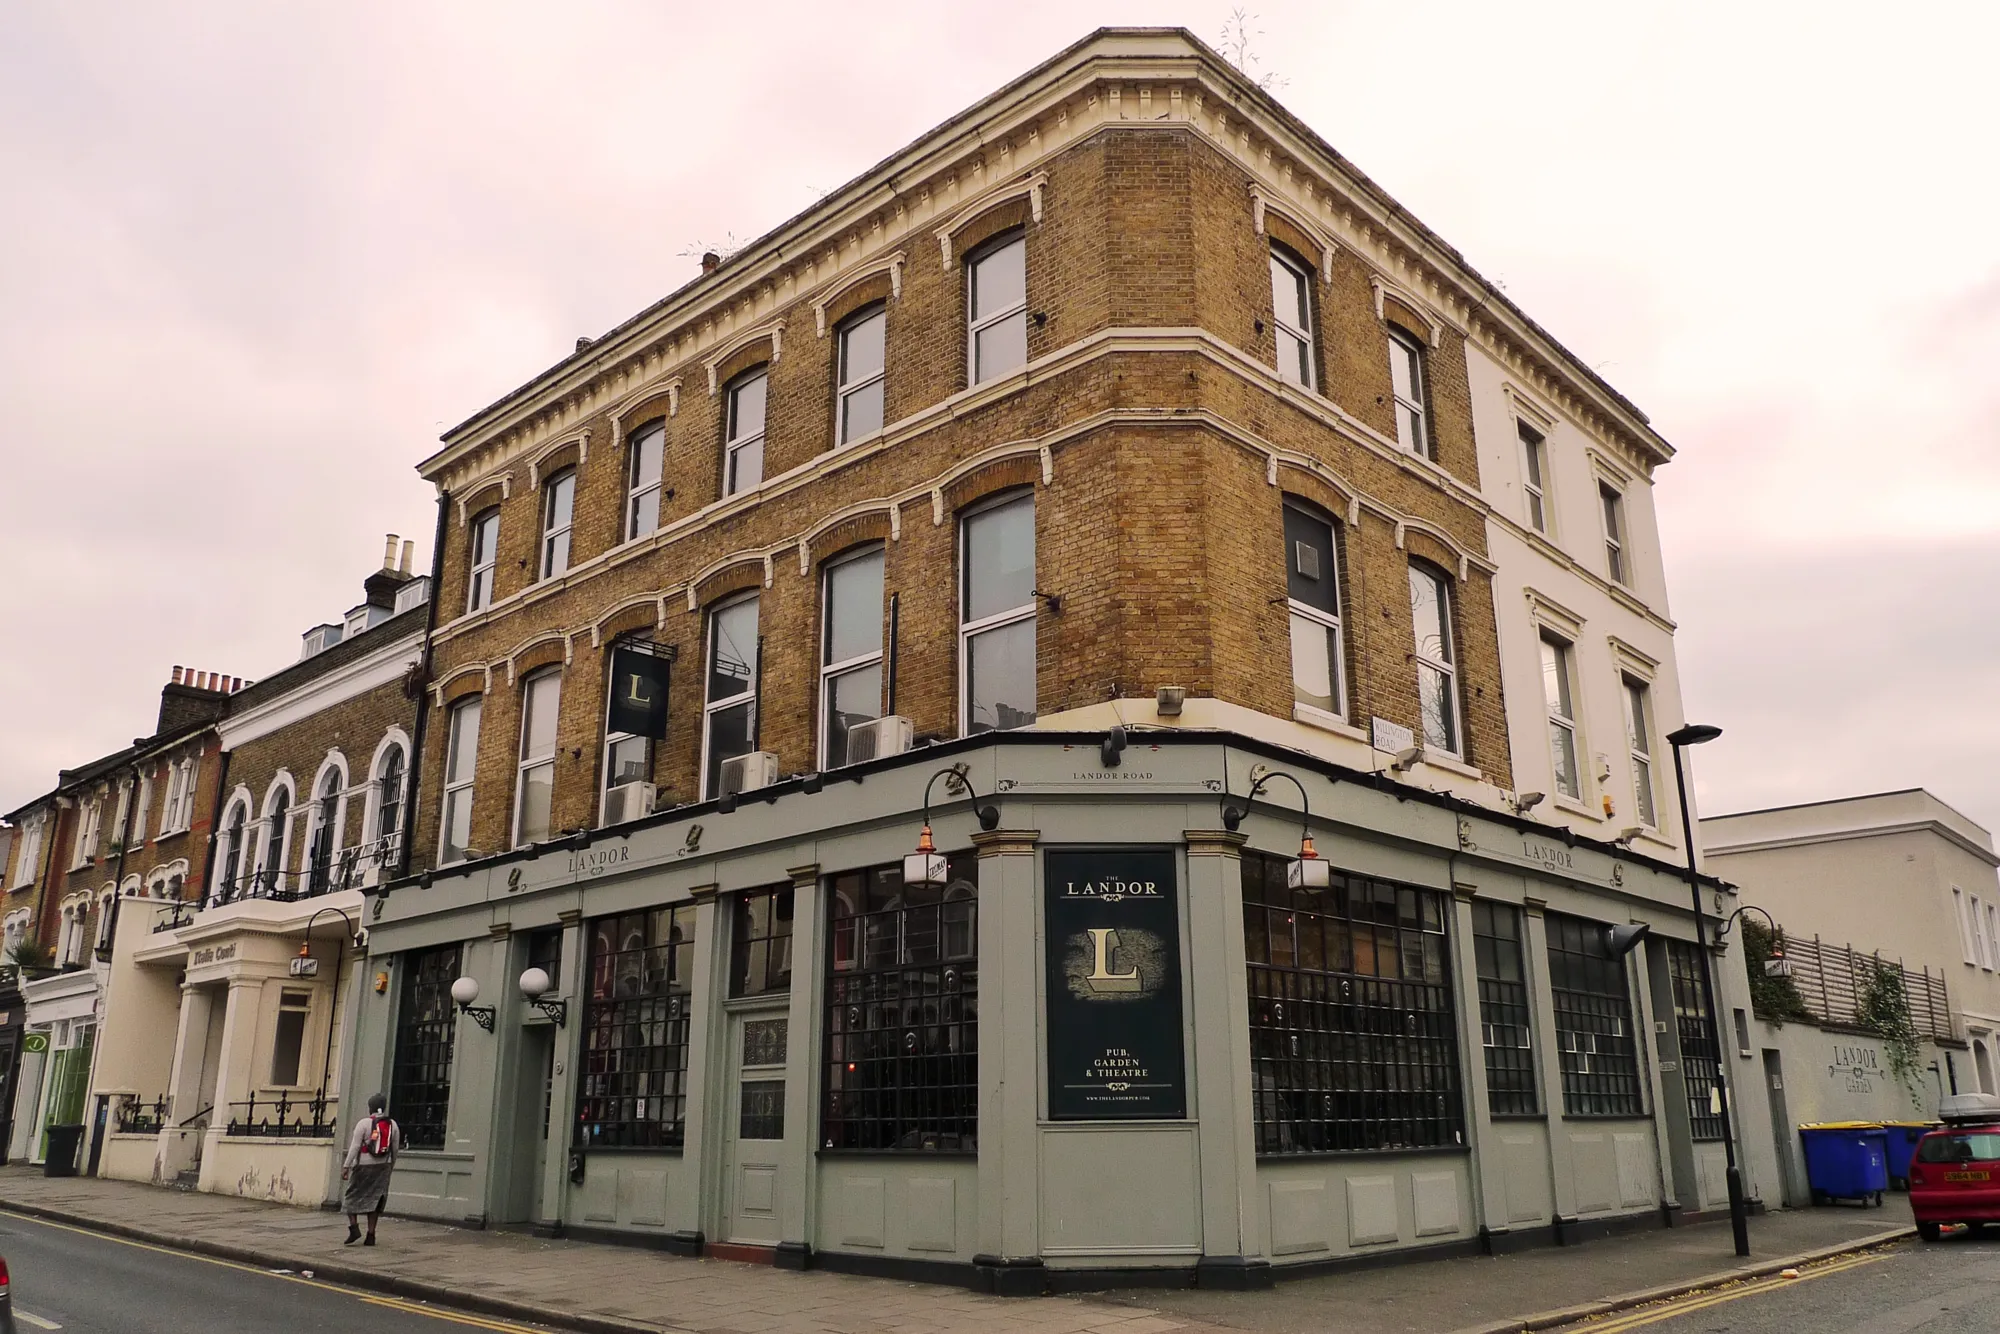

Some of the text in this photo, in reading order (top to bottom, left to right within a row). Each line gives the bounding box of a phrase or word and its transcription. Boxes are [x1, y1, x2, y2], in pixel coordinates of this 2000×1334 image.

[627, 673, 650, 703] L
[1374, 720, 1413, 742] WILLINGTON
[1375, 734, 1396, 751] ROAD
[1073, 772, 1153, 780] LANDOR ROAD
[568, 845, 629, 873] LANDOR
[1523, 841, 1573, 869] LANDOR
[1067, 882, 1157, 895] LANDOR
[1085, 928, 1143, 993] L
[1106, 1048, 1130, 1057] PUB,
[1833, 1045, 1878, 1069] LANDOR
[1094, 1059, 1139, 1067] GARDEN
[1086, 1069, 1148, 1077] & THEATRE
[1845, 1076, 1873, 1093] GARDEN
